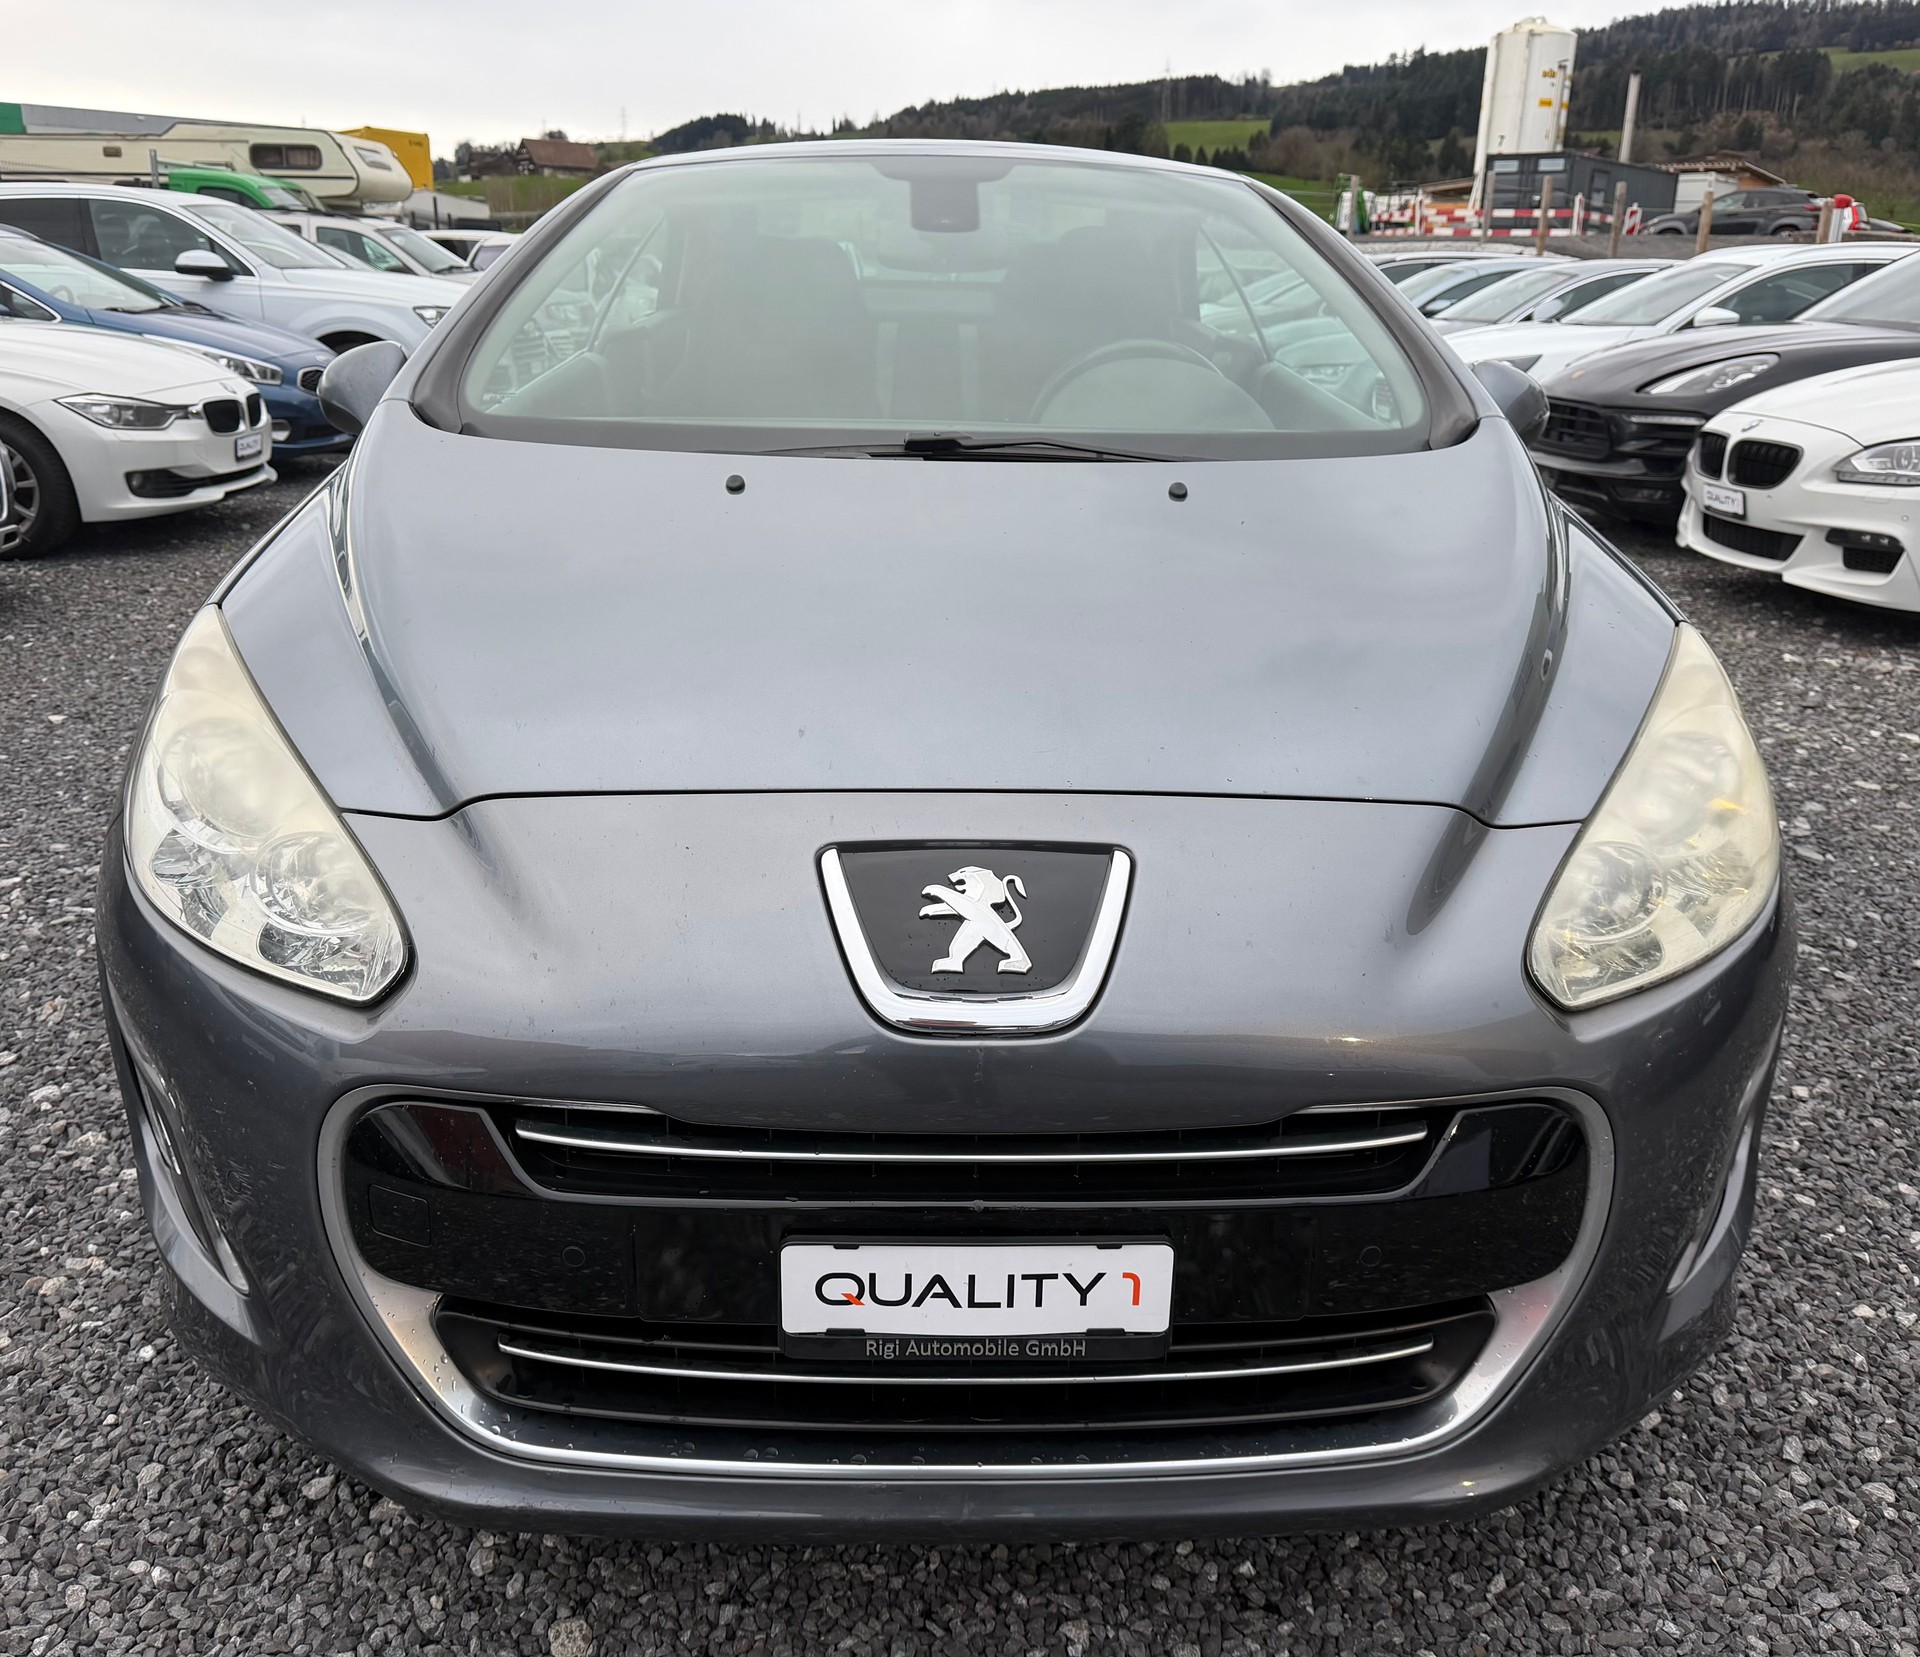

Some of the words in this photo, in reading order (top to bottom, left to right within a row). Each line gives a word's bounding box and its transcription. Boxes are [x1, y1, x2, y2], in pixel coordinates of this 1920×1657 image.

[815, 1272, 1107, 1308] QUALITY
[1122, 1272, 1141, 1306] 1
[865, 1339, 899, 1359] Rigi
[905, 1339, 1020, 1357] Automobile
[1025, 1339, 1086, 1357] GmbH
